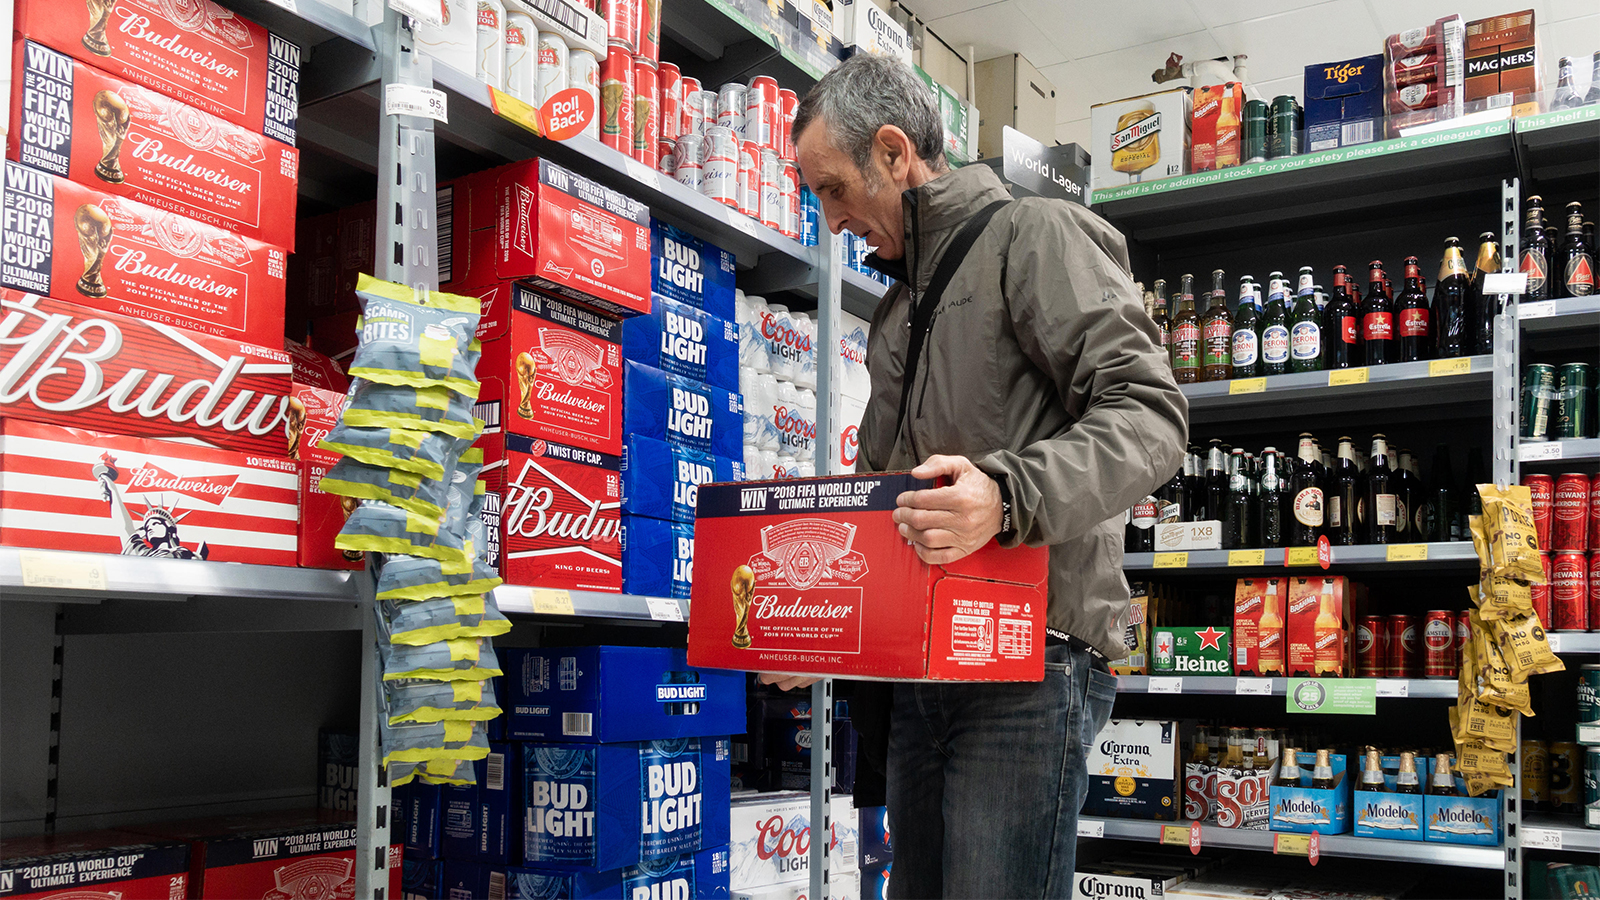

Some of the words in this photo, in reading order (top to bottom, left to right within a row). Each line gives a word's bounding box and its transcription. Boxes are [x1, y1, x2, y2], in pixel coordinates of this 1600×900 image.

[868, 7, 904, 53] Corona
[115, 5, 239, 80] Budweiser
[28, 47, 73, 82] WIN
[1469, 51, 1534, 73] MAGNERS
[1325, 63, 1364, 84] Tiger
[36, 76, 72, 100] 2018
[25, 90, 71, 122] FIFA
[552, 95, 579, 116] Roll
[1194, 100, 1218, 118] BRAHMA
[25, 111, 71, 136] WORLD
[550, 109, 585, 132] Back
[1520, 118, 1545, 128] This
[1550, 112, 1582, 123] shelf
[1111, 132, 1131, 150] San
[1130, 116, 1160, 138] Miguel
[1217, 130, 1236, 147] BRAHMA
[22, 154, 68, 175] EXPERIENCE
[23, 145, 68, 167] ULTIMATE
[127, 132, 252, 195] Budweiser
[1094, 192, 1113, 201] This
[1115, 188, 1139, 199] shelf
[1152, 183, 1166, 192] for
[1169, 174, 1222, 189] additional
[1224, 167, 1255, 180] stock.
[1259, 162, 1278, 173] For
[1280, 158, 1306, 173] your
[1308, 152, 1344, 167] safety
[1346, 146, 1384, 162] please
[1387, 140, 1408, 151] ask
[1420, 127, 1486, 150] colleague
[1488, 123, 1505, 132] for
[1120, 152, 1151, 162] ESPECIAL
[1012, 148, 1049, 179] World
[1052, 167, 1081, 197] Lager
[1171, 164, 1179, 173] 12
[548, 167, 568, 191] WIN
[573, 179, 590, 193] 2018
[591, 184, 604, 198] FIFA
[605, 190, 626, 206] WORLD
[664, 237, 700, 269] BUD
[110, 244, 239, 299] Budweiser
[660, 257, 704, 293] LIGHT
[365, 305, 409, 322] SCAMPI
[520, 289, 542, 313] WIN
[546, 299, 562, 311] 2018
[563, 304, 576, 315] FIFA
[578, 308, 599, 325] WORLD
[363, 322, 409, 343] BITES
[551, 310, 576, 326] ULTIMATE
[579, 320, 609, 337] EXPERIENCE
[666, 311, 703, 342] BUD
[760, 305, 811, 351] Coors
[1369, 323, 1390, 331] Estrella
[1405, 318, 1427, 328] Estrella
[661, 331, 707, 365] LIGHT
[772, 341, 800, 362] LIGHT
[535, 380, 605, 413] Budweiser
[673, 387, 709, 417] BUD
[668, 408, 713, 440] LIGHT
[773, 405, 816, 438] Coors
[782, 432, 809, 450] LIGHT
[548, 445, 571, 460] TWIST
[572, 450, 585, 462] OFF
[587, 453, 602, 465] CAP.
[129, 466, 233, 496] Budweiser
[740, 488, 768, 512] WIN
[774, 486, 795, 498] 2018
[797, 484, 816, 497] FIFA
[818, 482, 852, 495] WORLD
[778, 498, 815, 509] ULTIMATE
[818, 496, 868, 508] EXPERIENCE
[1296, 490, 1310, 510] BIRRA
[1505, 532, 1521, 540] NO
[753, 595, 853, 619] Budweiser
[1236, 596, 1261, 613] BRAHMA
[1290, 596, 1316, 612] BRAHMA
[1046, 628, 1070, 641] VAUDE
[1259, 633, 1279, 648] BRAHMA
[1316, 634, 1337, 648] BRAHMA
[1512, 631, 1526, 641] NO
[1175, 656, 1228, 672] Heine
[1493, 667, 1509, 675] NO
[1521, 657, 1534, 665] FREE
[658, 687, 677, 699] BUD
[679, 686, 705, 699] LIGHT
[1302, 692, 1318, 701] 25
[515, 707, 528, 715] BUD
[530, 707, 549, 715] LIGHT
[1100, 740, 1150, 757] Corona
[1114, 755, 1140, 765] Extra
[648, 761, 696, 798] BUD
[533, 781, 588, 809] BUD
[1217, 776, 1270, 828] SOL
[642, 793, 701, 834] LIGHT
[1282, 799, 1320, 814] Modelo
[1368, 804, 1408, 819] Modelo
[1439, 807, 1482, 824] Modelo
[527, 807, 594, 837] LIGHT
[23, 866, 51, 879] 2018
[53, 863, 75, 875] FIFA
[77, 858, 115, 873] WORLD
[31, 874, 77, 888] ULTIMATE
[79, 867, 132, 882] EXPERIENCE
[1079, 876, 1145, 899] Corona
